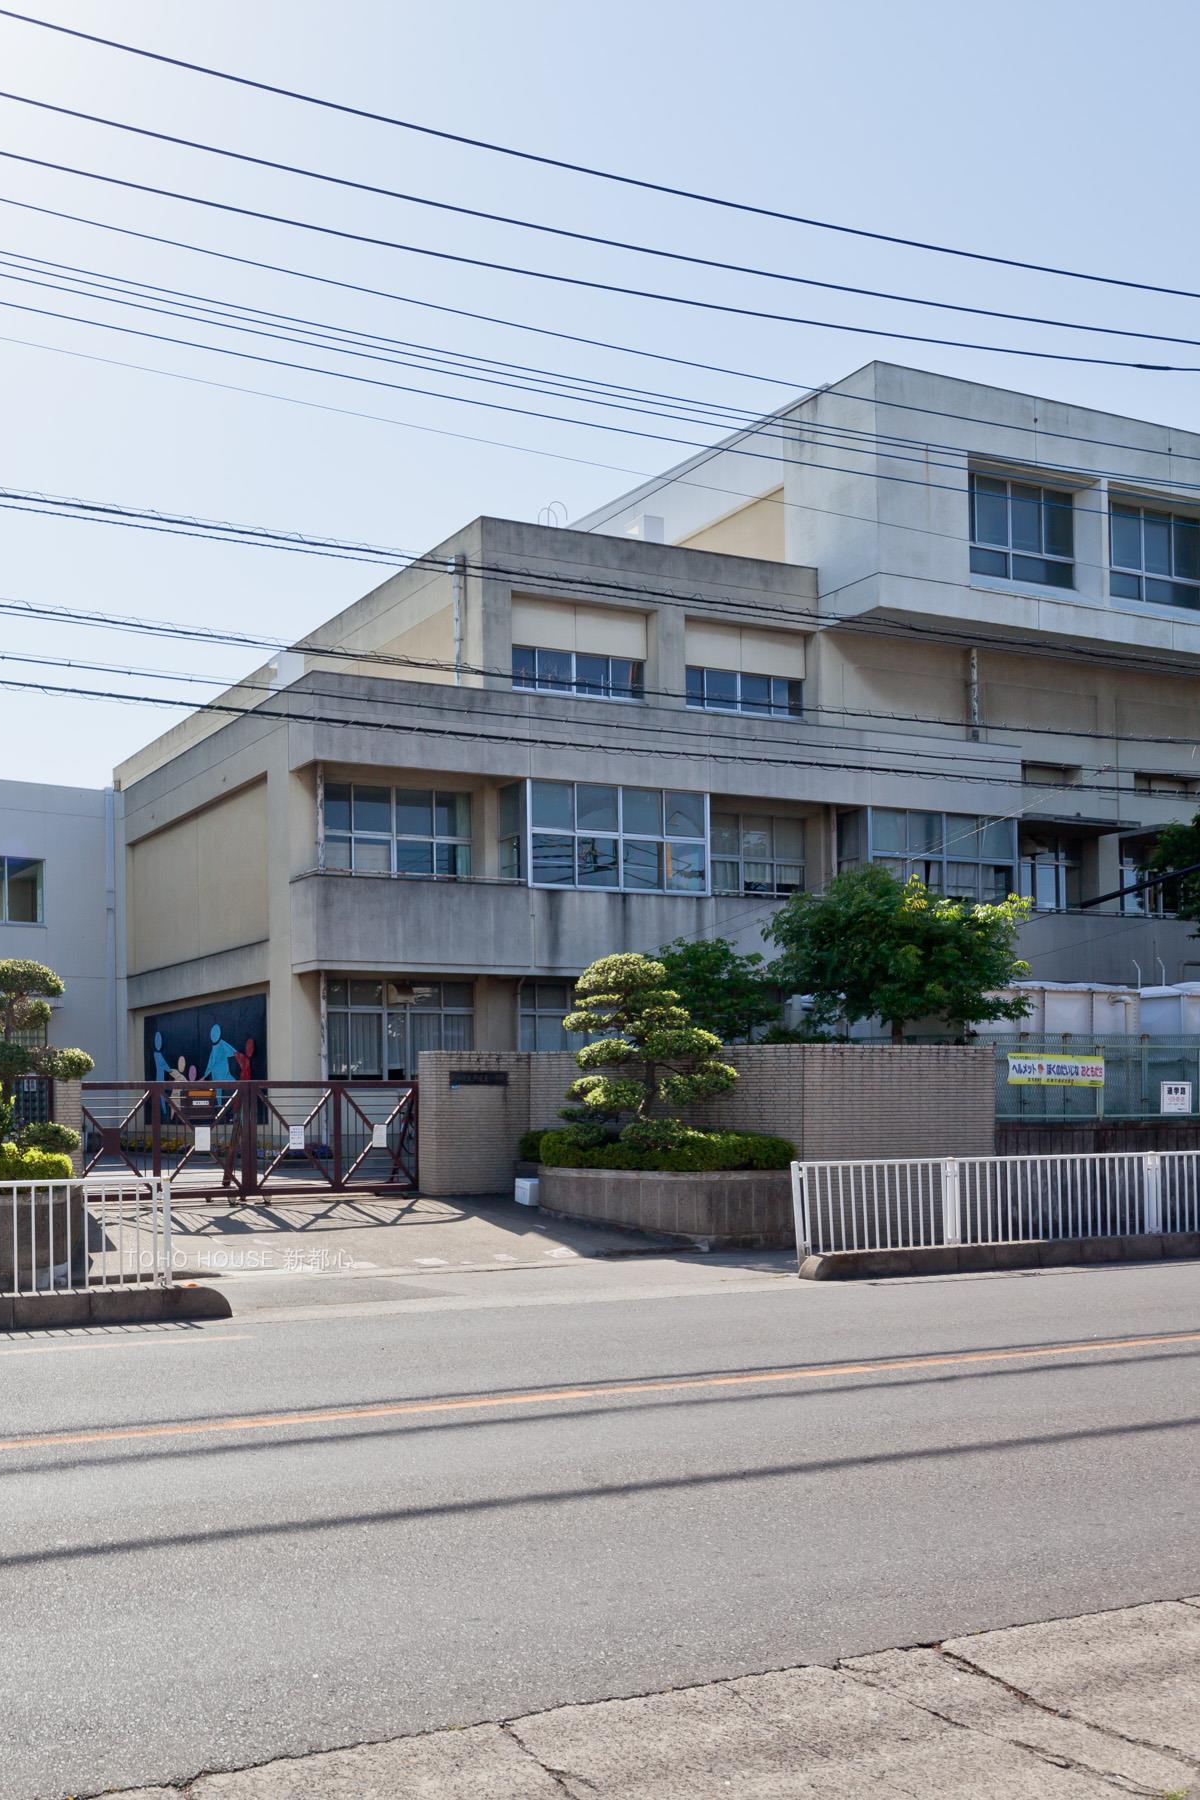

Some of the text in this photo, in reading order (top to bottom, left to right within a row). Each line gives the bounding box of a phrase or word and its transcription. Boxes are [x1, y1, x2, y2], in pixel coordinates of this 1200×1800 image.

[1011, 1063, 1037, 1075] ヘルメット
